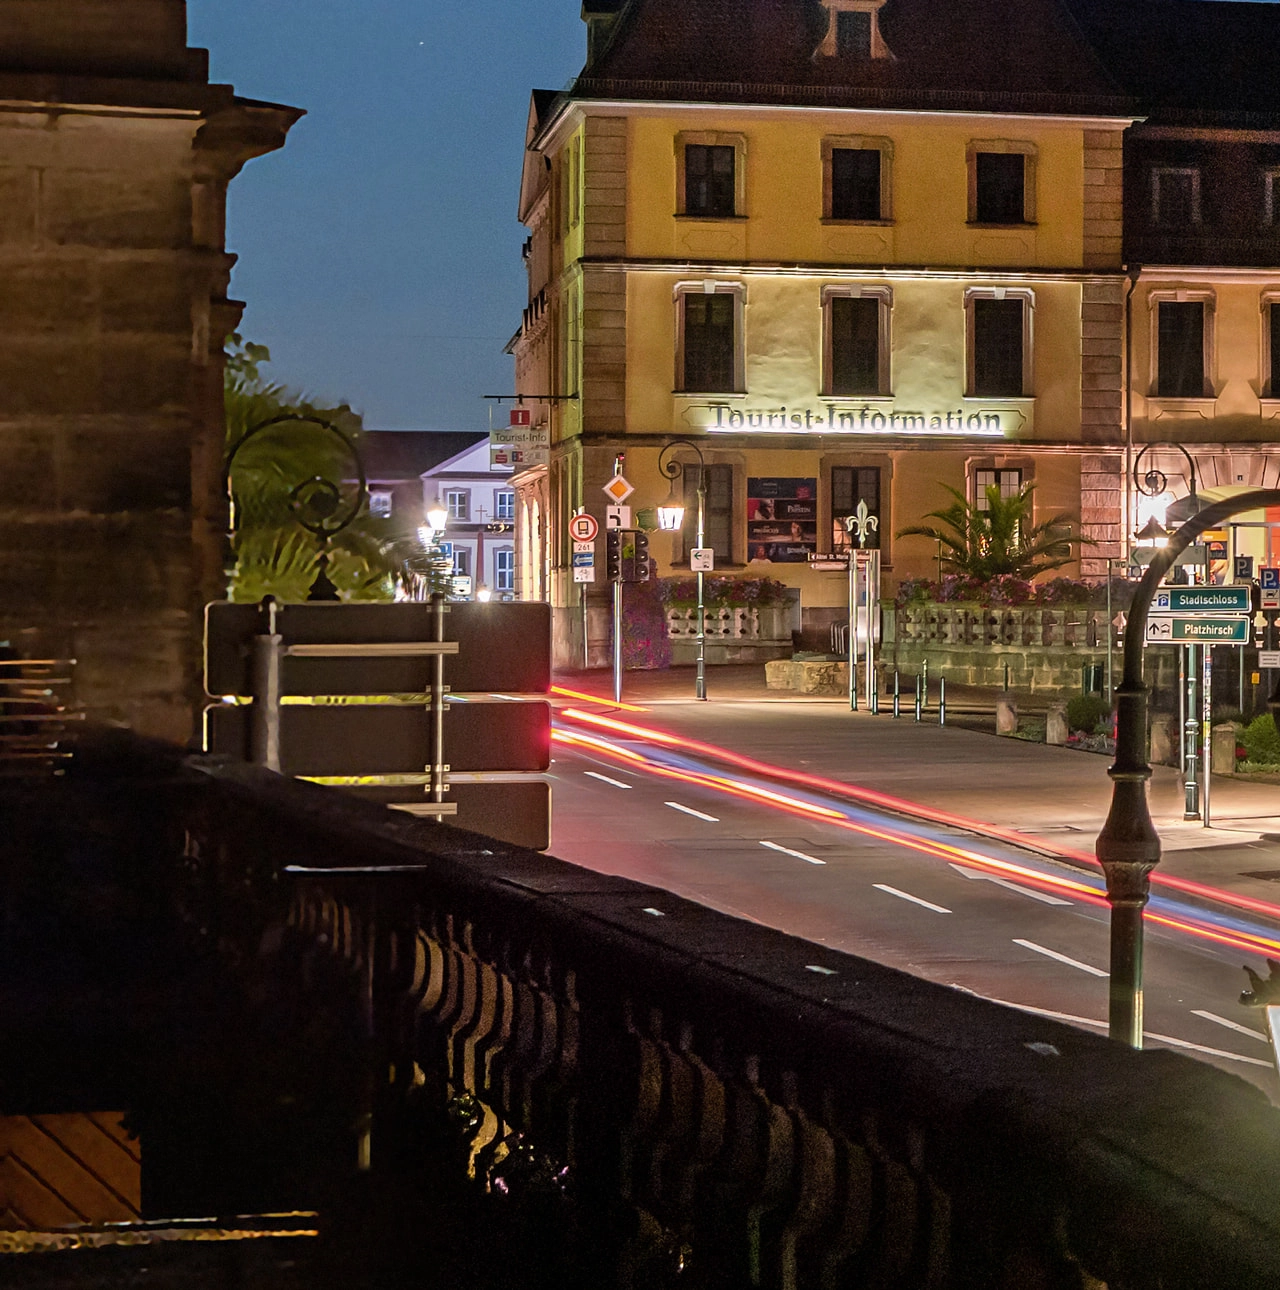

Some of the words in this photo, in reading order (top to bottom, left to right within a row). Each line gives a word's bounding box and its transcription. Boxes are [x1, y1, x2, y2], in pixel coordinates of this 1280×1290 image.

[709, 406, 1001, 431] Tourist-Information
[495, 433, 547, 442] Tourist-Info
[1179, 594, 1238, 605] Stadtschloss
[1184, 624, 1233, 635] Platzhirsch
